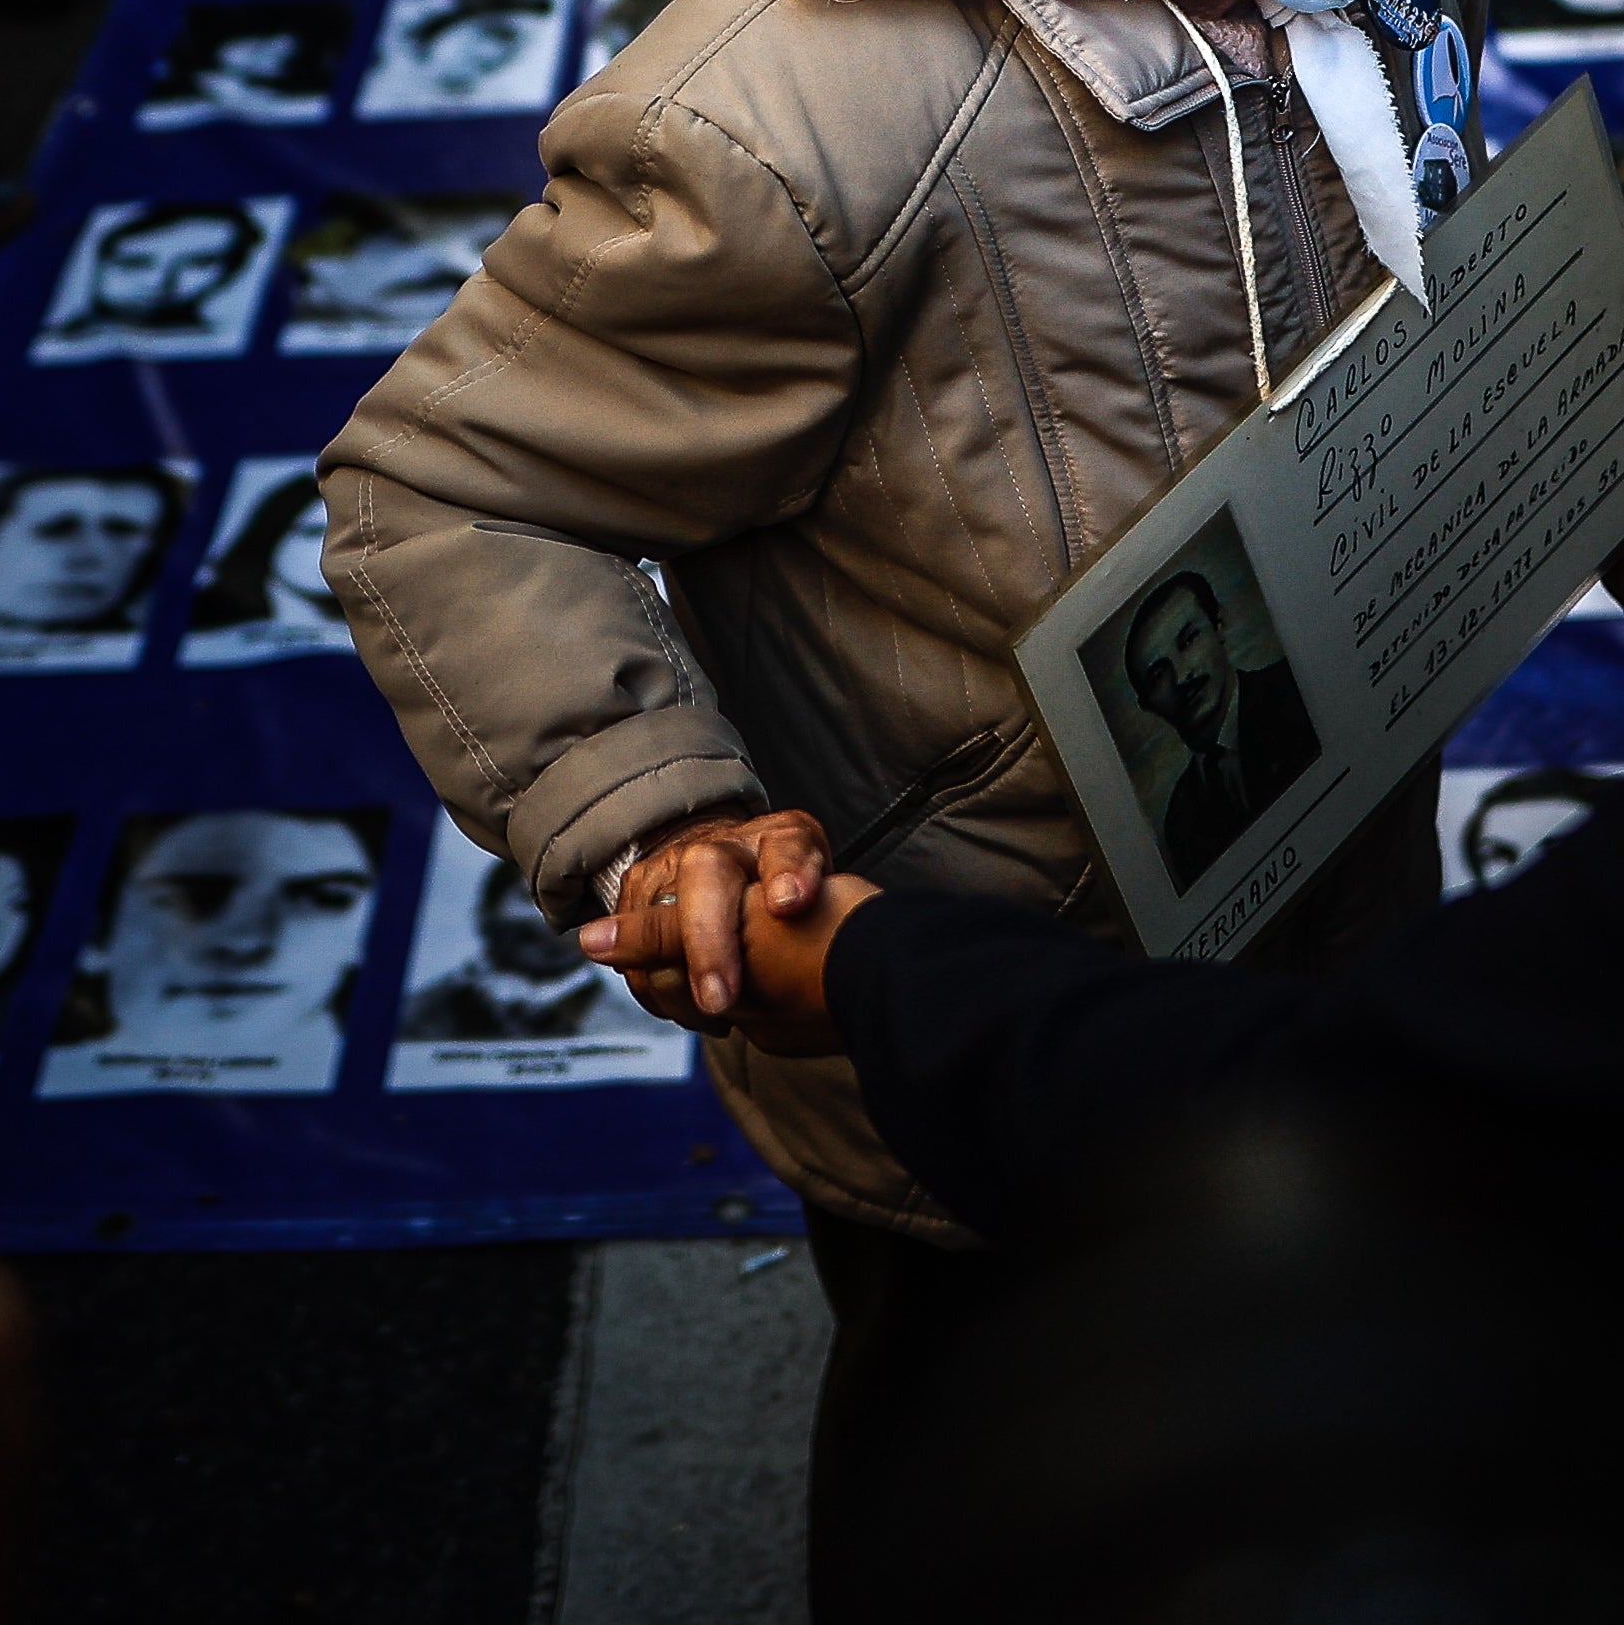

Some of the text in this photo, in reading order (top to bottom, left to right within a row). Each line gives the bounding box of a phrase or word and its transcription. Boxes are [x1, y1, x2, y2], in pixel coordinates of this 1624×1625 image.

[1295, 320, 1408, 454] CARLOS
[1412, 450, 1442, 490] DE
[1449, 411, 1474, 454] LA
[1354, 598, 1377, 634] DE
[1527, 415, 1549, 450] LA
[1389, 684, 1411, 714] EL
